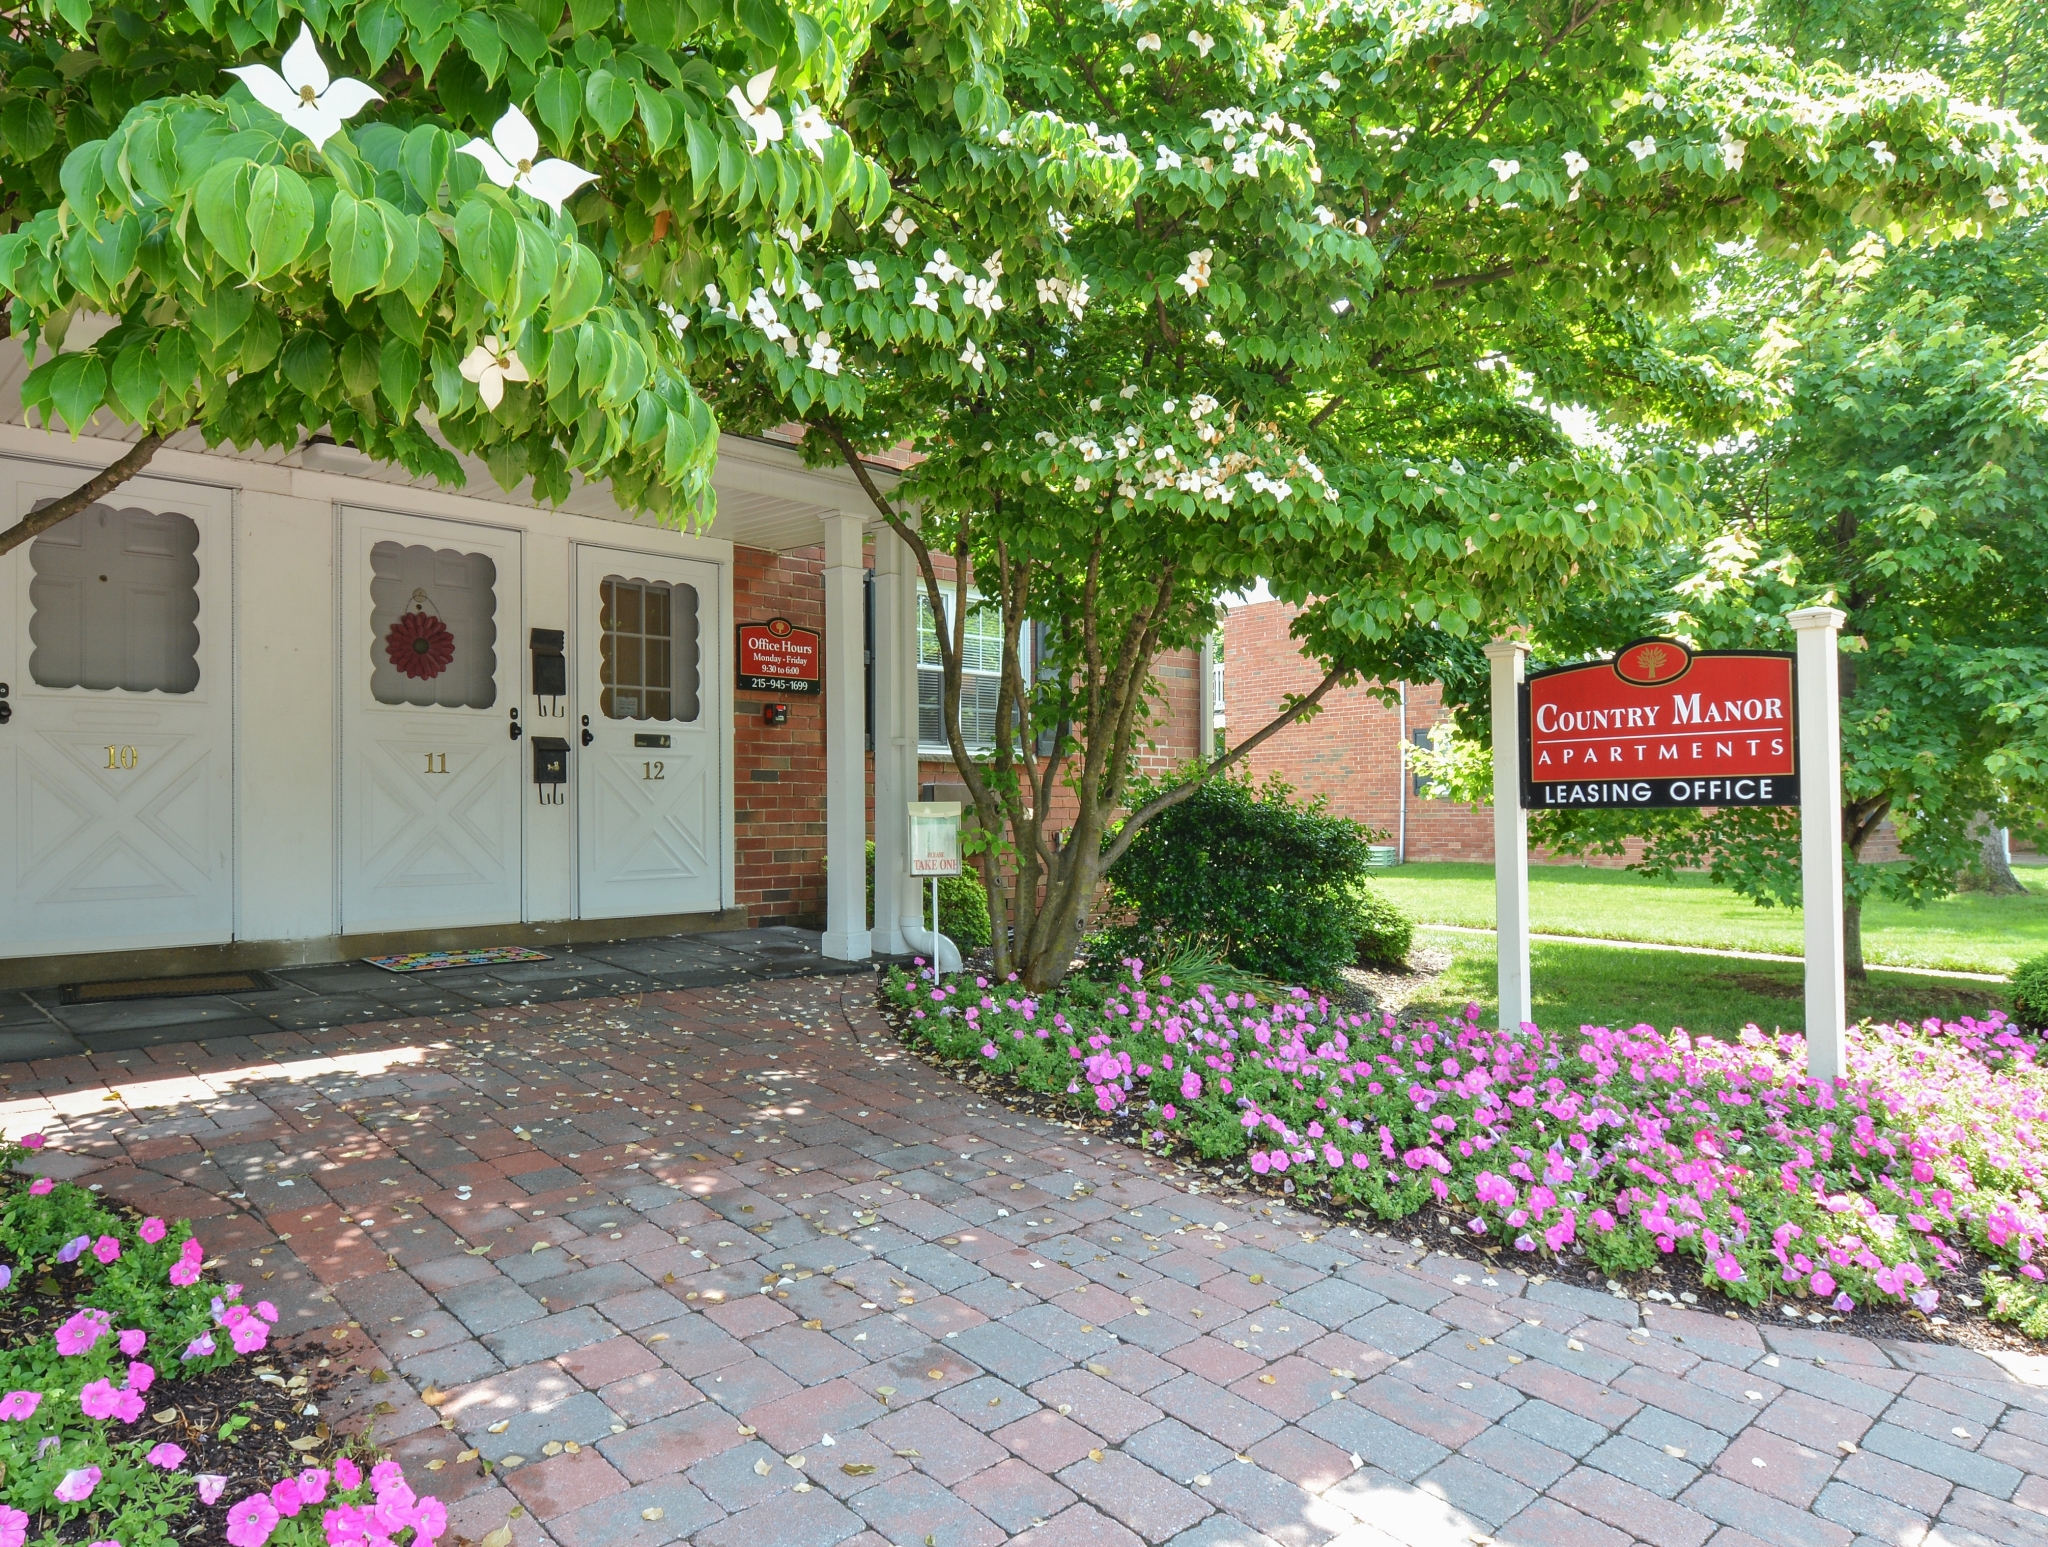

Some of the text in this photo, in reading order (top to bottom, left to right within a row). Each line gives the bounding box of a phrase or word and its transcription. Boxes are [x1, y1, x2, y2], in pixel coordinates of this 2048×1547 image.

[748, 637, 812, 654] Office Hours
[753, 652, 782, 664] Monday
[786, 655, 808, 667] Friday
[761, 664, 800, 675] 9:30 to 6:00
[751, 677, 808, 691] 215-945-1699
[1536, 692, 1784, 733] COUNTRY MANOR
[103, 744, 138, 770] 10
[1537, 738, 1784, 766] APARTMENTS
[424, 752, 450, 774] 11
[642, 761, 665, 780] 12
[1545, 779, 1773, 804] LEASING OFFICE
[914, 859, 958, 871] TAKE ONE
